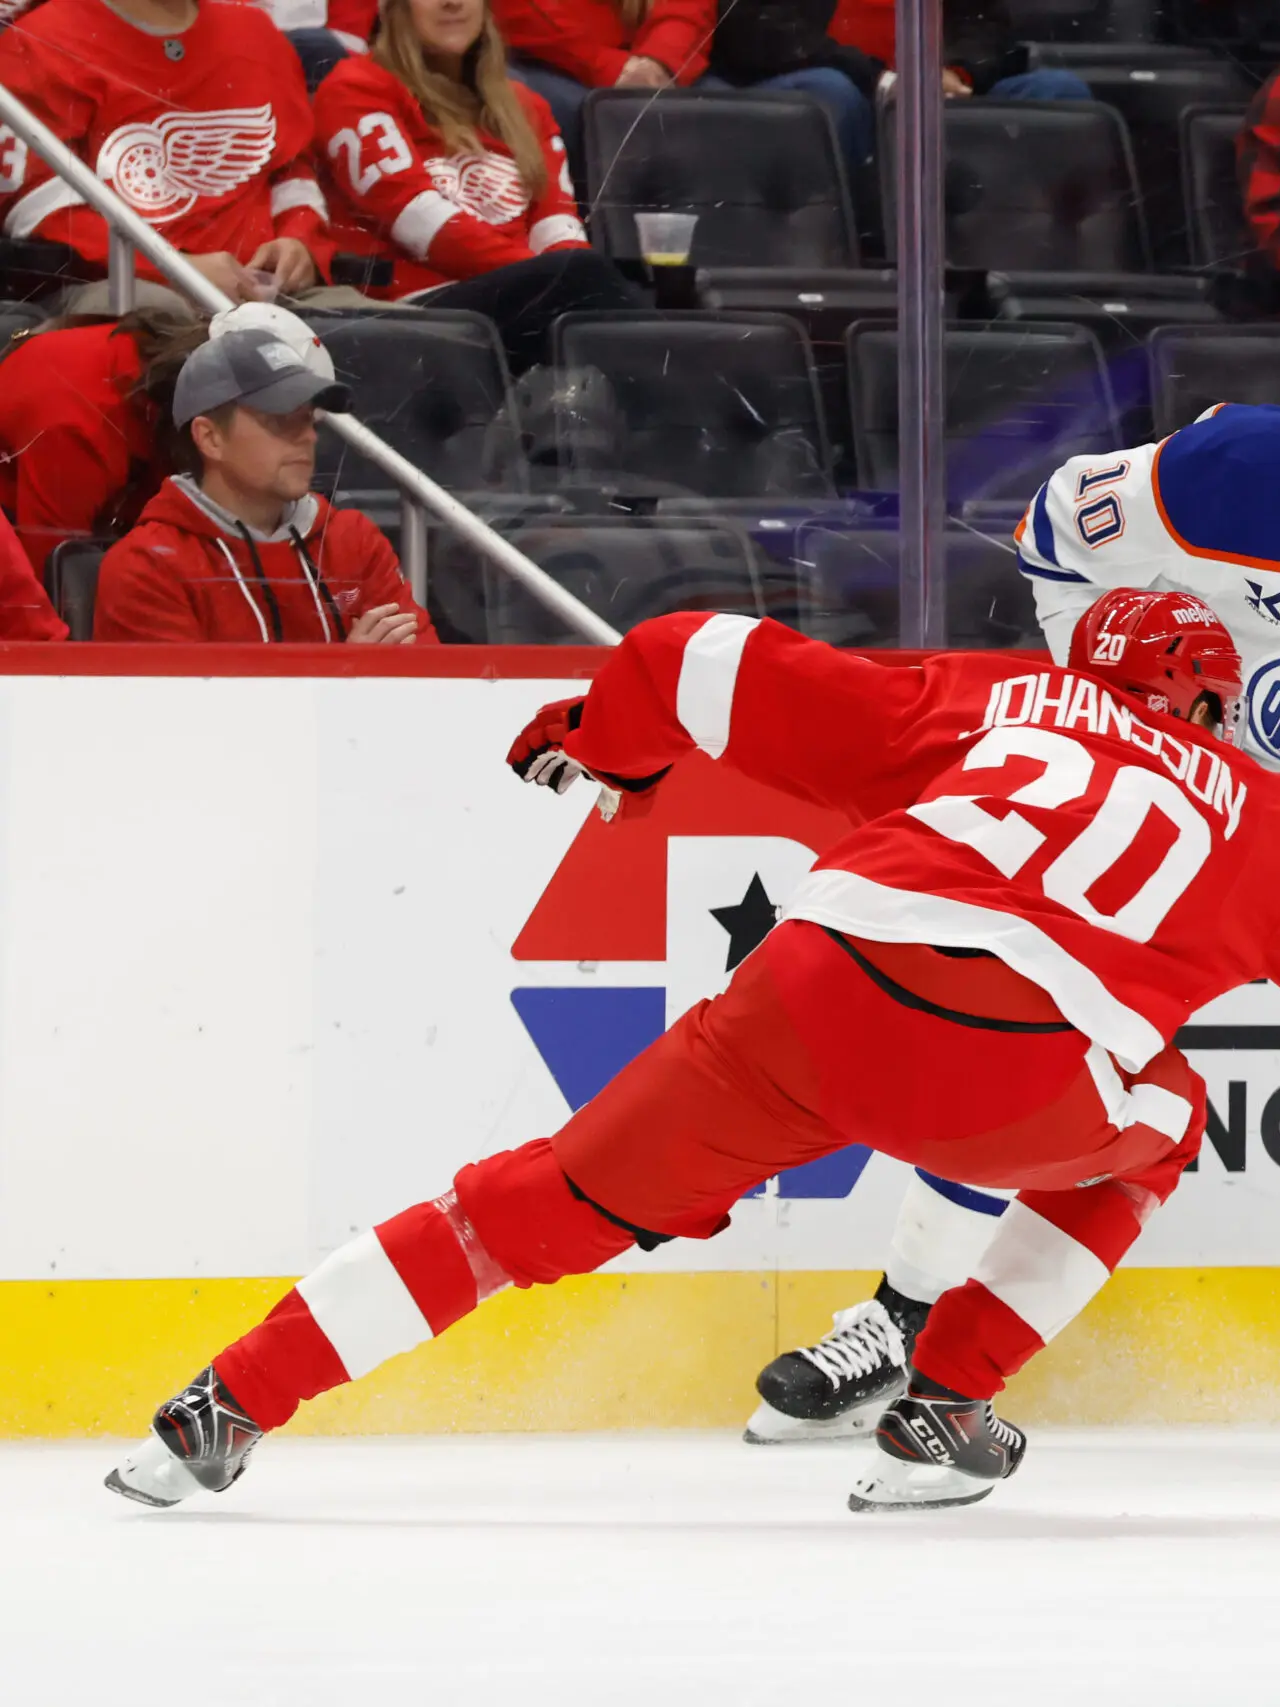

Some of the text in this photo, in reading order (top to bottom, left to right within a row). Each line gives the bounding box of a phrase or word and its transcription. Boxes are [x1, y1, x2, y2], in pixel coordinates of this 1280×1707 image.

[328, 111, 413, 196] 23
[1073, 459, 1131, 551] 10
[1092, 632, 1127, 662] 20
[957, 672, 1248, 841] JOHANSSON
[906, 726, 1212, 944] 20
